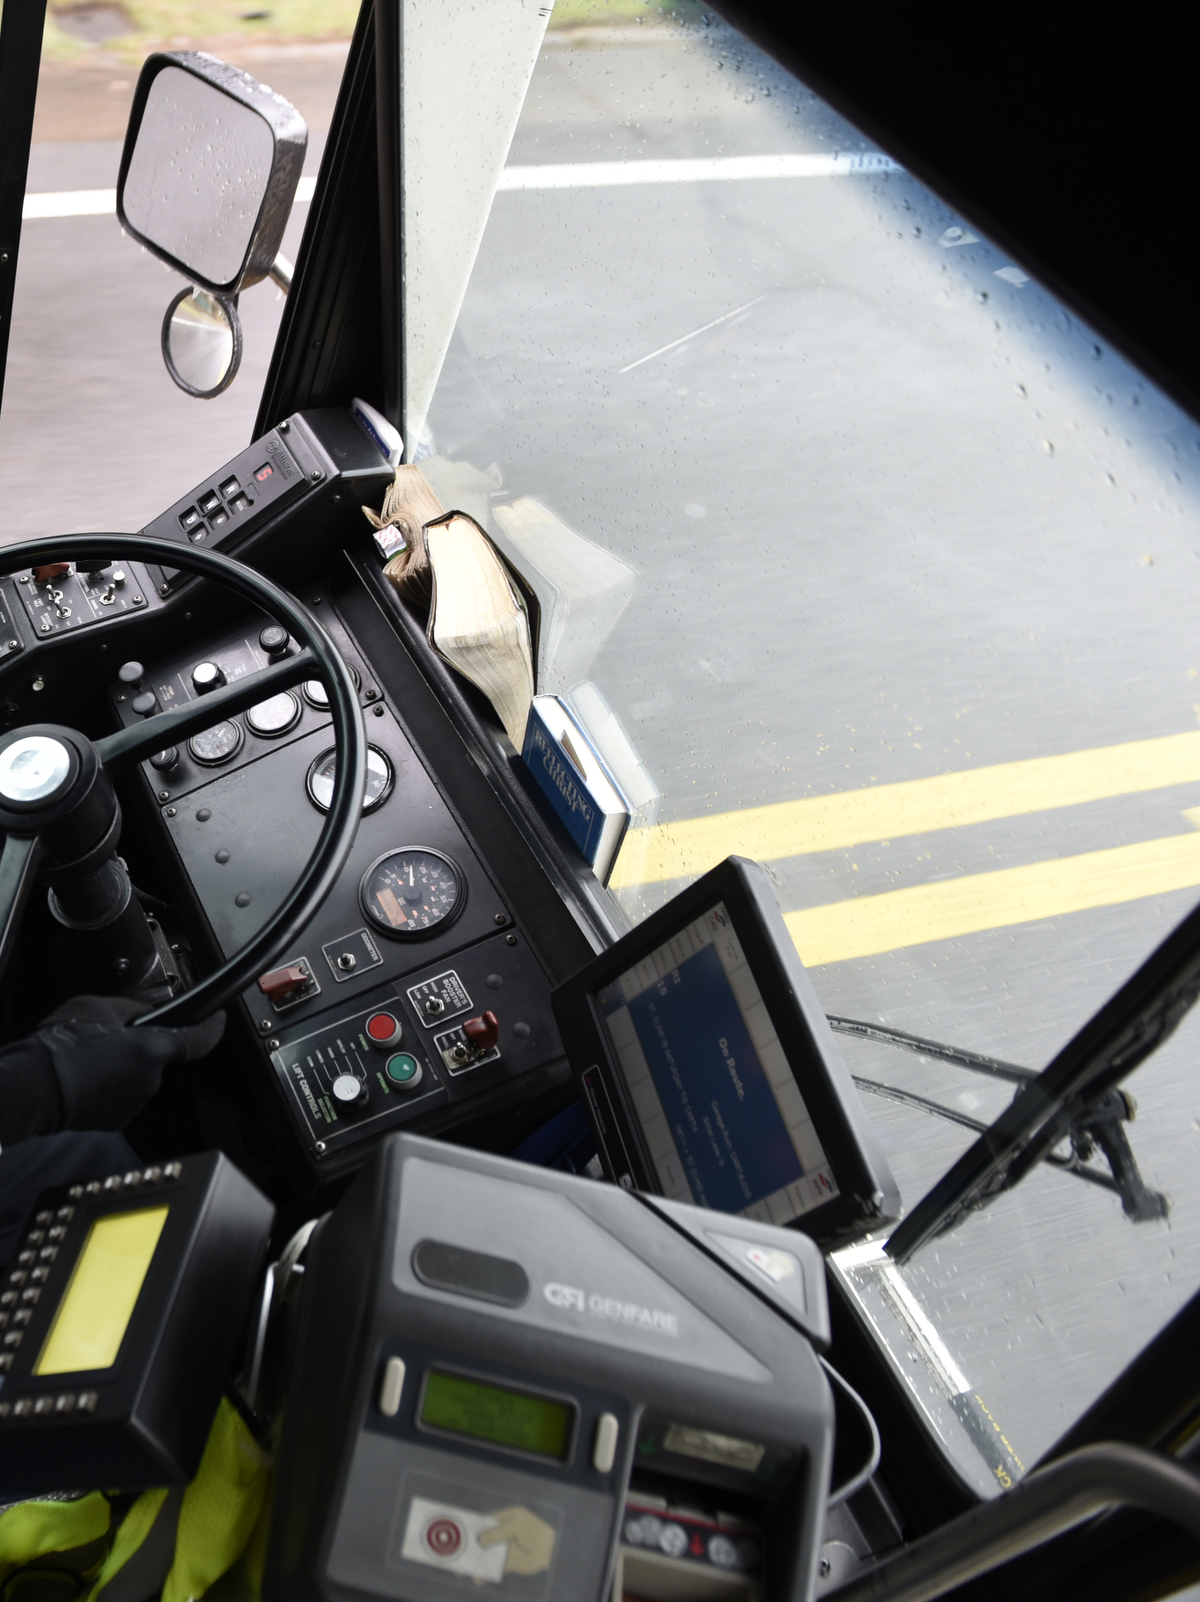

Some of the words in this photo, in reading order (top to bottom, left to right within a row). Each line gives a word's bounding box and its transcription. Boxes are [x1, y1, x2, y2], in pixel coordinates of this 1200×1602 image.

[278, 450, 295, 477] Allison
[226, 485, 235, 493] R
[205, 501, 214, 509] N
[186, 516, 194, 524] D
[534, 729, 590, 822] REFLECTING
[542, 755, 578, 812] CHRIST
[361, 932, 378, 960] ODOMETER
[430, 981, 438, 992] HIGH
[656, 980, 668, 996] 15
[670, 970, 682, 985] Rt
[413, 989, 421, 999] LOW
[441, 989, 450, 1002] FAN
[442, 978, 461, 1008] BOOSTER
[448, 976, 466, 1005] DRIVER'S
[651, 1016, 665, 1038] ELMO
[358, 1033, 369, 1051] POWER
[662, 1049, 685, 1091] SATURDAY
[717, 1037, 731, 1056] On
[724, 1058, 748, 1101] Route.
[292, 1062, 304, 1079] LIFT
[299, 1079, 321, 1119] CONTROLS
[376, 1071, 389, 1094] OPERATE
[317, 1097, 331, 1123] SELECTOR
[323, 1095, 337, 1120] FUNCTION
[679, 1091, 689, 1104] TO
[596, 1109, 607, 1134] Devices
[683, 1105, 699, 1133] CARTA
[690, 1168, 704, 1192] ELMO
[587, 1294, 680, 1336] GENFARE
